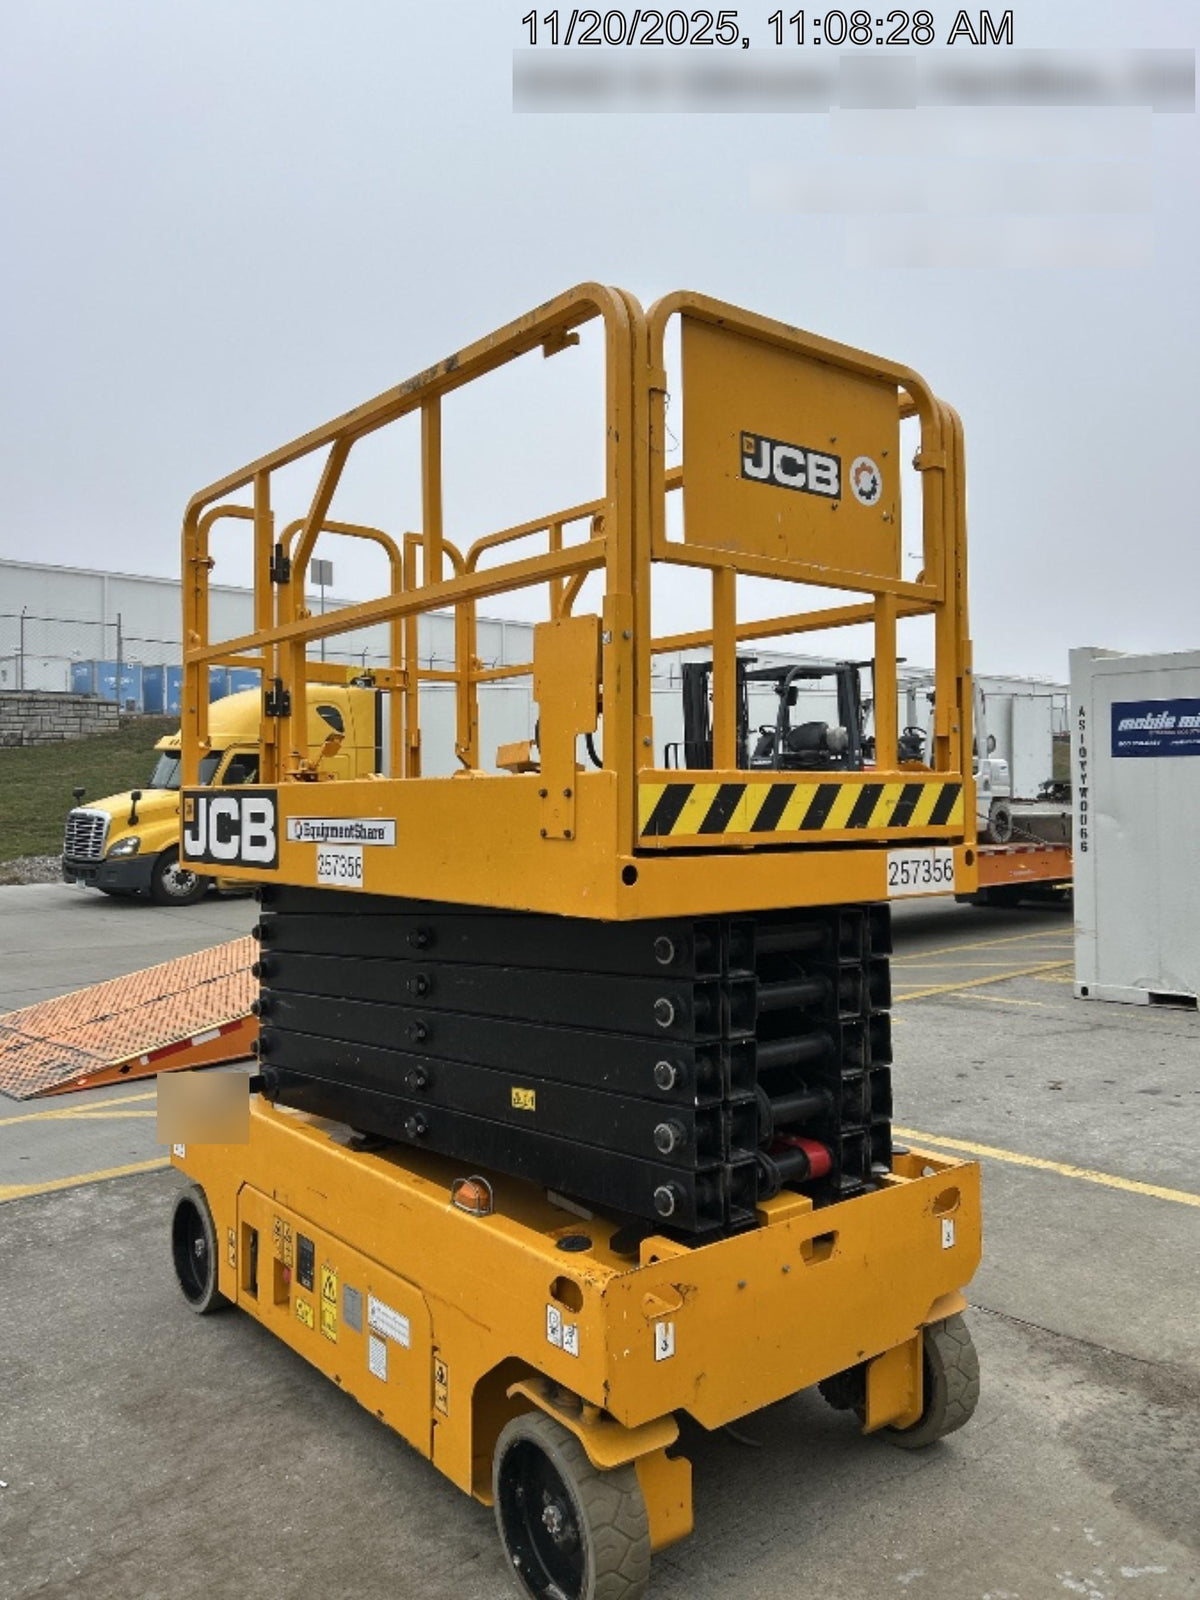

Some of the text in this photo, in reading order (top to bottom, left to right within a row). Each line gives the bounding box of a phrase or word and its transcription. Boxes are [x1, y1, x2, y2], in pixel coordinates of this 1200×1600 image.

[743, 439, 840, 495] JCB
[184, 797, 276, 863] JCB
[303, 821, 386, 841] EquipmentShare
[317, 854, 362, 879] 257356
[888, 858, 954, 886] 257356
